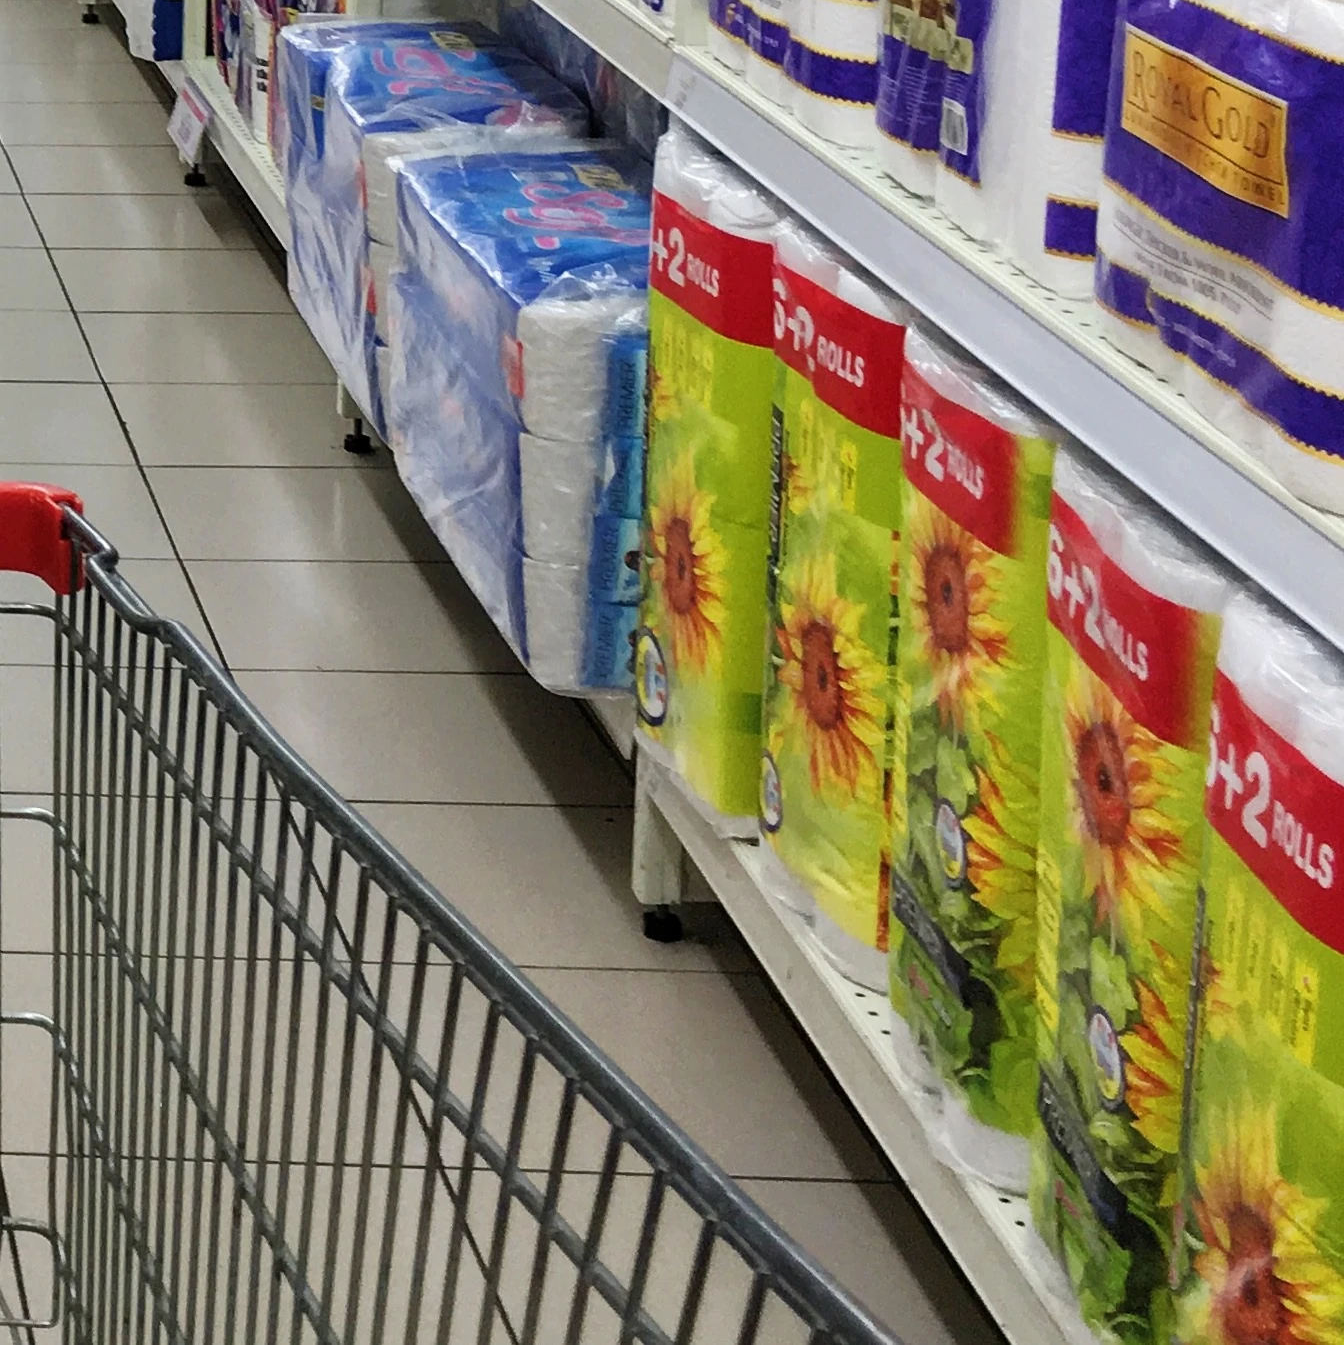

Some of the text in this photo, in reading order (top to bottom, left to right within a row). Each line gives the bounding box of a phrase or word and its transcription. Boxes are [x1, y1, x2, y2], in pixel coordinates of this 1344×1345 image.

[1131, 51, 1272, 159] ROYAL GOLD
[686, 254, 721, 298] ROLLS
[816, 335, 866, 388] ROLLS
[946, 442, 985, 501] ROLLS
[1048, 524, 1105, 650] 6+2
[1271, 801, 1335, 890] ROLLS
